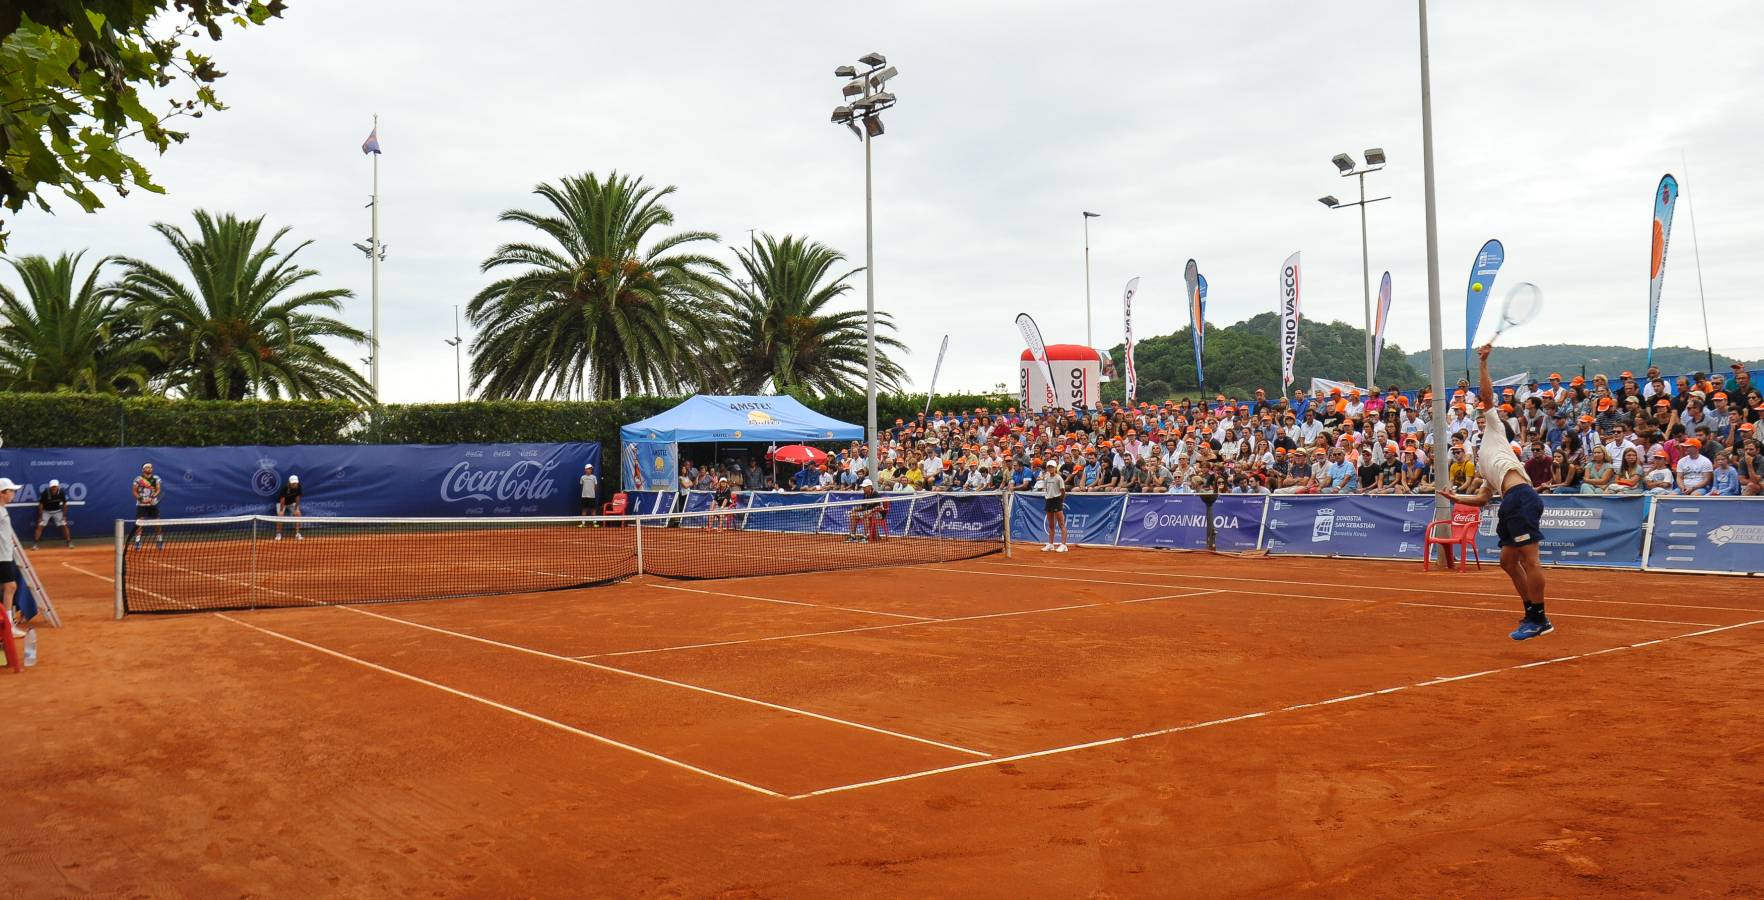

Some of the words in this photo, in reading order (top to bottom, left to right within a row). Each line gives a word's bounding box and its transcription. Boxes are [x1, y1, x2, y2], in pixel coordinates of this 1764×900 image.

[1285, 266, 1295, 317] VASCO
[1285, 319, 1296, 371] IARIO
[1071, 367, 1083, 409] ASCO
[440, 460, 561, 502] Coca-Cola
[1453, 514, 1475, 522] Coca-Cola
[1542, 509, 1594, 517] AURLARITZA
[941, 521, 982, 531] HEAD
[1056, 514, 1089, 528] FET
[1160, 515, 1239, 528] ORAINKIOLA
[1558, 519, 1586, 527] VASCO
